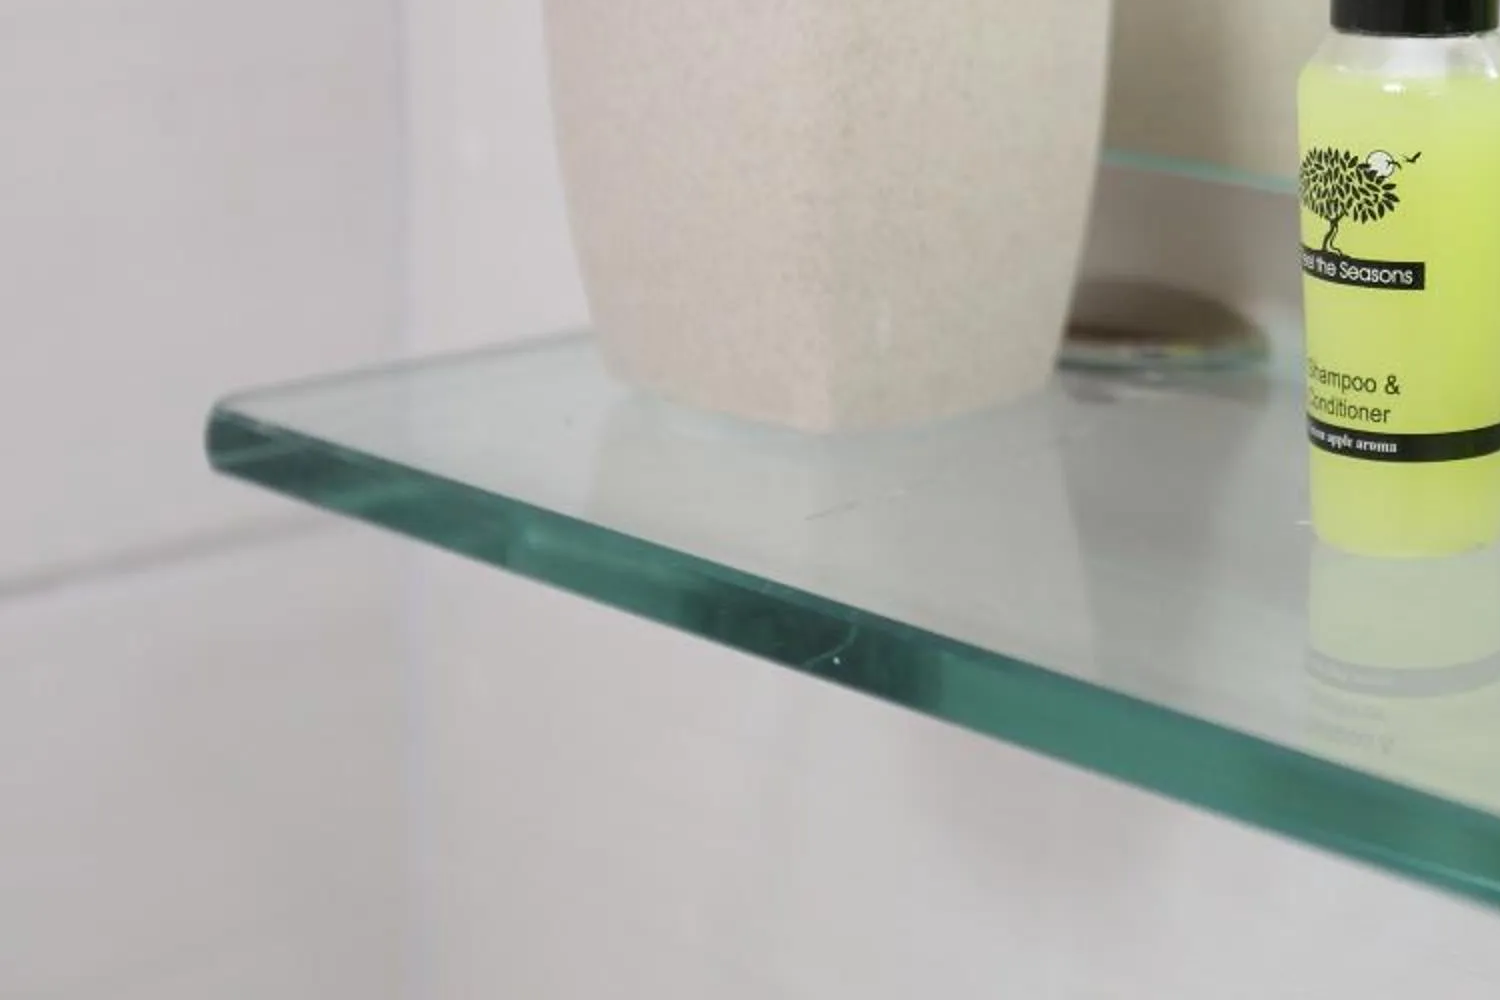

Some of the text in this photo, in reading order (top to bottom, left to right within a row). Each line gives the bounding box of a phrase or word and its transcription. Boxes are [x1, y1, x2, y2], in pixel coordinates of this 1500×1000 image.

[1315, 255, 1337, 277] the
[1339, 260, 1414, 285] Seasons
[1384, 374, 1401, 395] &
[1355, 438, 1398, 453] aroma
